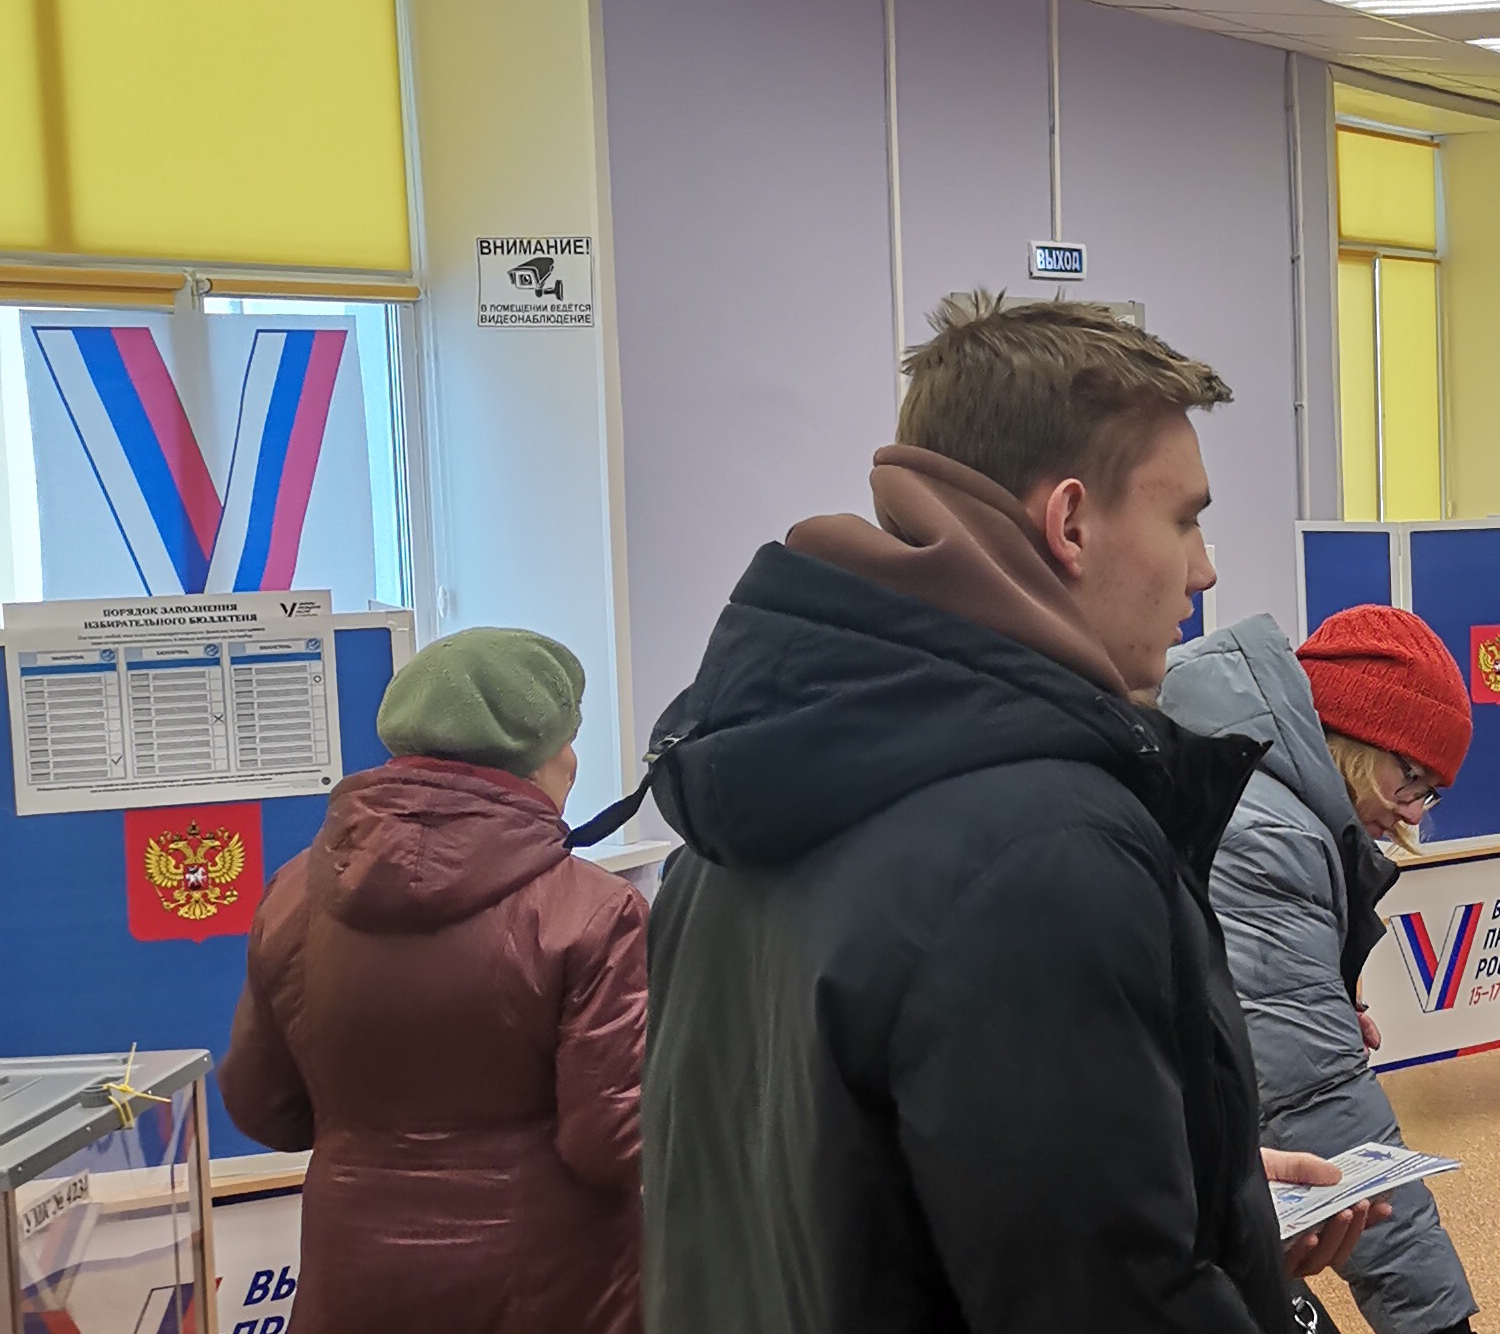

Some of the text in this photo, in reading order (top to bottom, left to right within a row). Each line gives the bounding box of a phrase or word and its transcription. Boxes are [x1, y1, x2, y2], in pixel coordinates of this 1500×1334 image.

[479, 239, 590, 255] ВНИМАНИЕ!
[1036, 248, 1081, 270] ВЫХОД
[480, 314, 591, 324] ВИДЕОНАБЛЮДЕНИЕ
[103, 607, 158, 617] ПОРЯДОК
[83, 617, 187, 629] ИЗБИРАТЕЛЬНОГО
